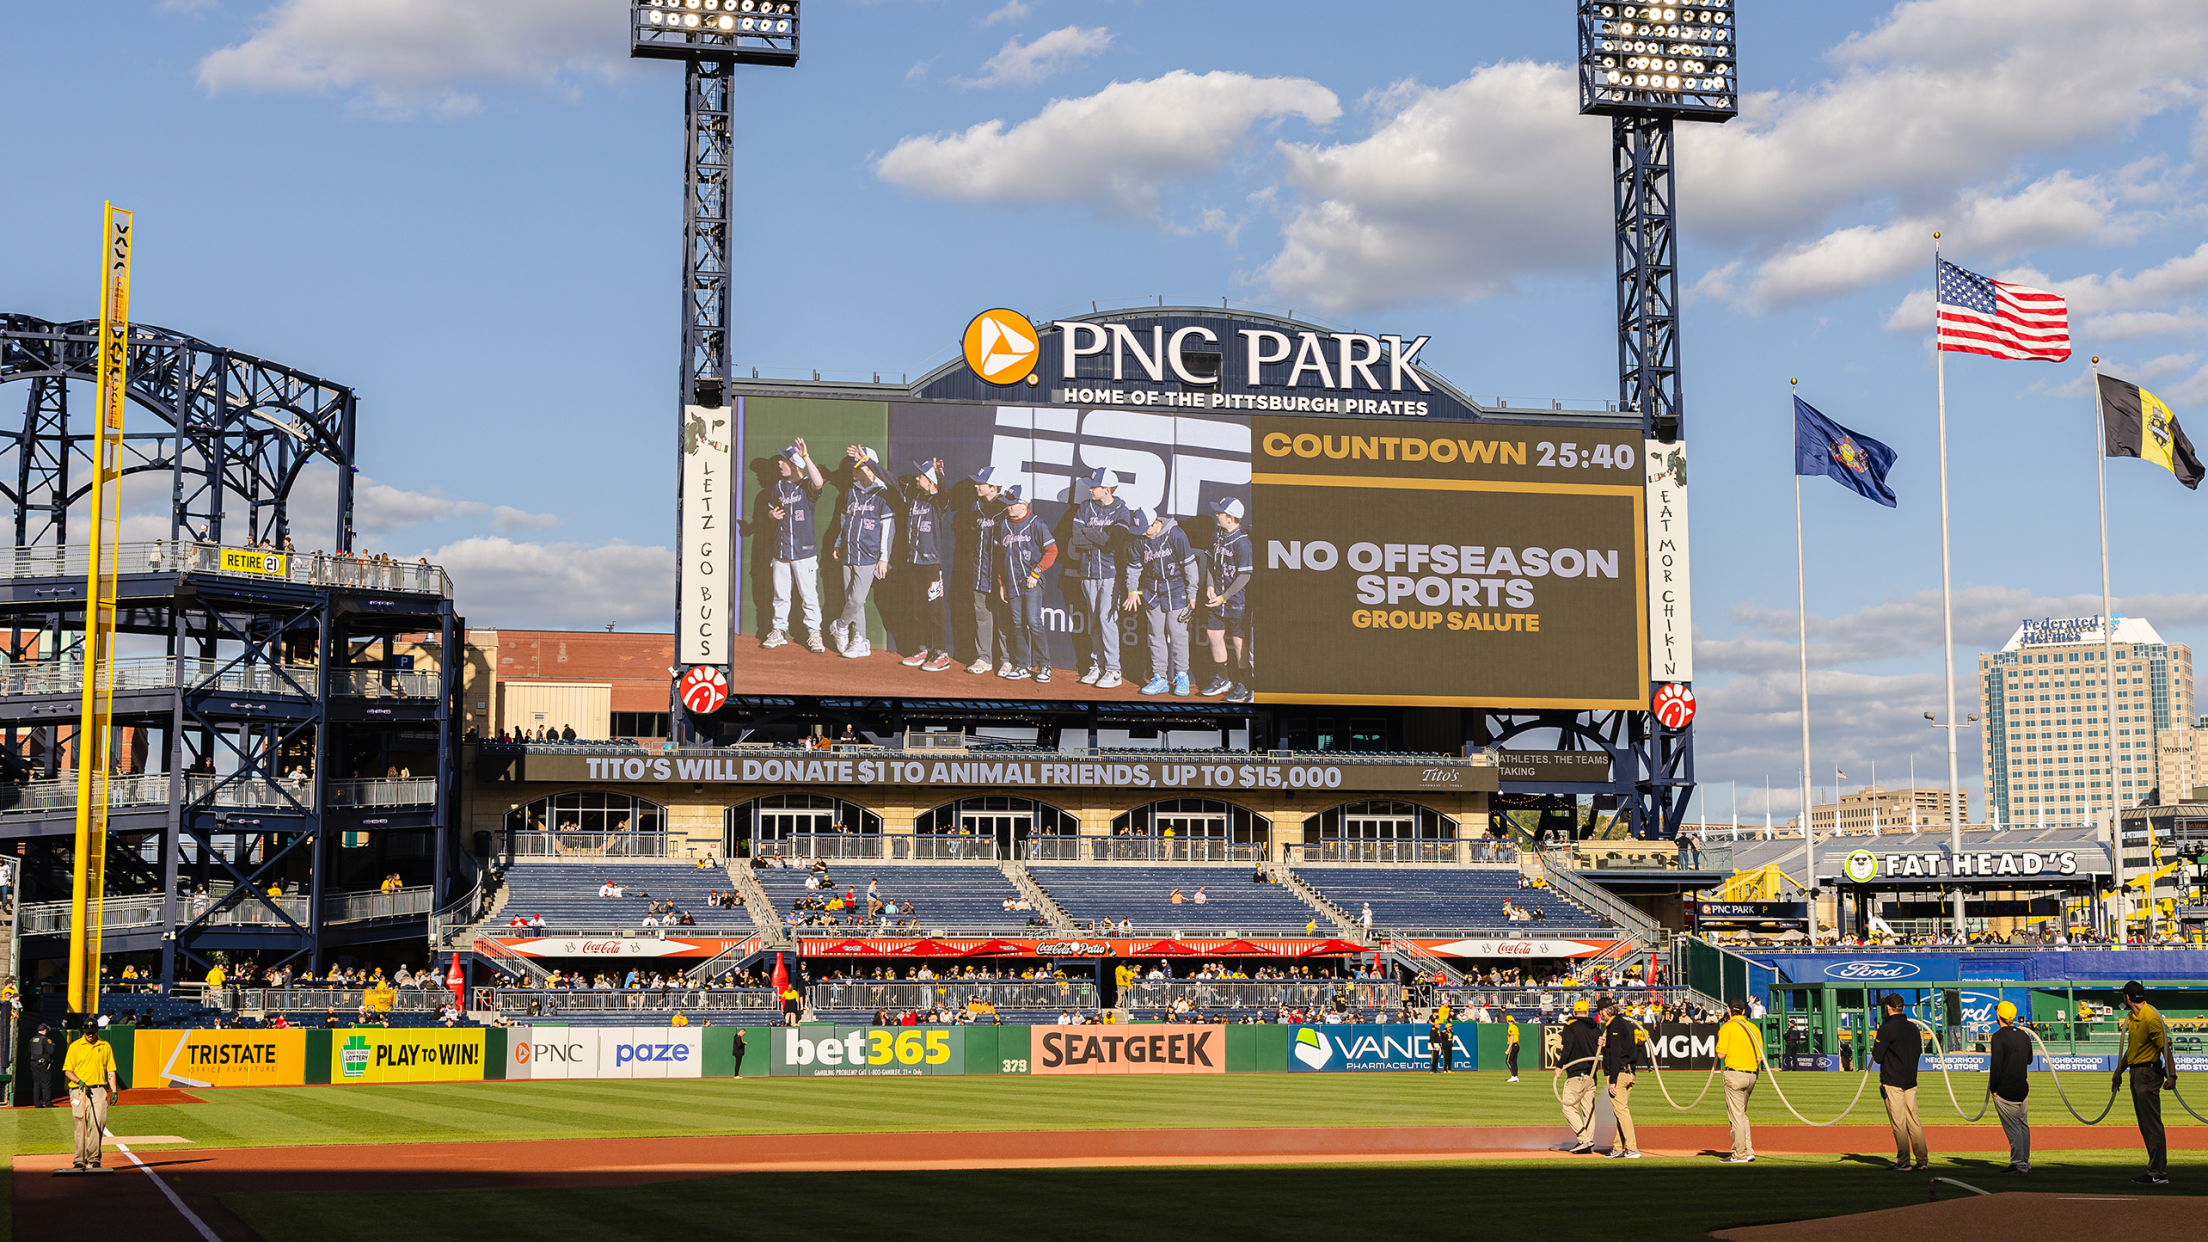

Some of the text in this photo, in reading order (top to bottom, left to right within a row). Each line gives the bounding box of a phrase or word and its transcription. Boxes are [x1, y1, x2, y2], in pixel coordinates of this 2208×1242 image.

[1054, 321, 1431, 392] PNC PARK
[1064, 388, 1428, 416] HOME OF THE PITTSBURGH PIRATES
[1262, 432, 1635, 470] COUNTDOWN 25:40
[227, 554, 277, 571] RETIRE 21
[699, 462, 715, 656] LETZ GO BUCS
[1268, 540, 1339, 571] NO
[1347, 542, 1619, 578] OFFSEASON
[1356, 575, 1534, 609] SPORTS
[1659, 490, 1676, 675] EAT MOR CHIKIN
[1352, 609, 1540, 632] GROUP SALUTE
[2022, 614, 2099, 630] Federated
[2023, 632, 2082, 643] Hermes
[401, 657, 408, 667] P
[1499, 754, 1609, 765] ATHLETES, THE TEAMS
[586, 757, 1341, 789] TITO'S WILL DONATE $1 TO ANIMAL FRIENDS, UP TO $15,000
[1422, 768, 1459, 782] Tito's
[1500, 767, 1535, 776] TAKING
[1885, 851, 2077, 877] FAT HEAD'S
[1711, 905, 1731, 914] PNC
[1732, 905, 1754, 914] PARK
[1077, 943, 1105, 955] Patio
[1840, 963, 1904, 977] Ford
[187, 1044, 276, 1064] TRISTATE
[376, 1043, 479, 1066] PLAY TO WIN!
[534, 1044, 584, 1062] PNC
[616, 1043, 690, 1067] paze
[785, 1028, 951, 1065] bet365
[1042, 1031, 1214, 1067] SEATGEEK
[1002, 1059, 1027, 1072] 379
[1346, 1061, 1472, 1070] PHARMACEUTICL INC.
